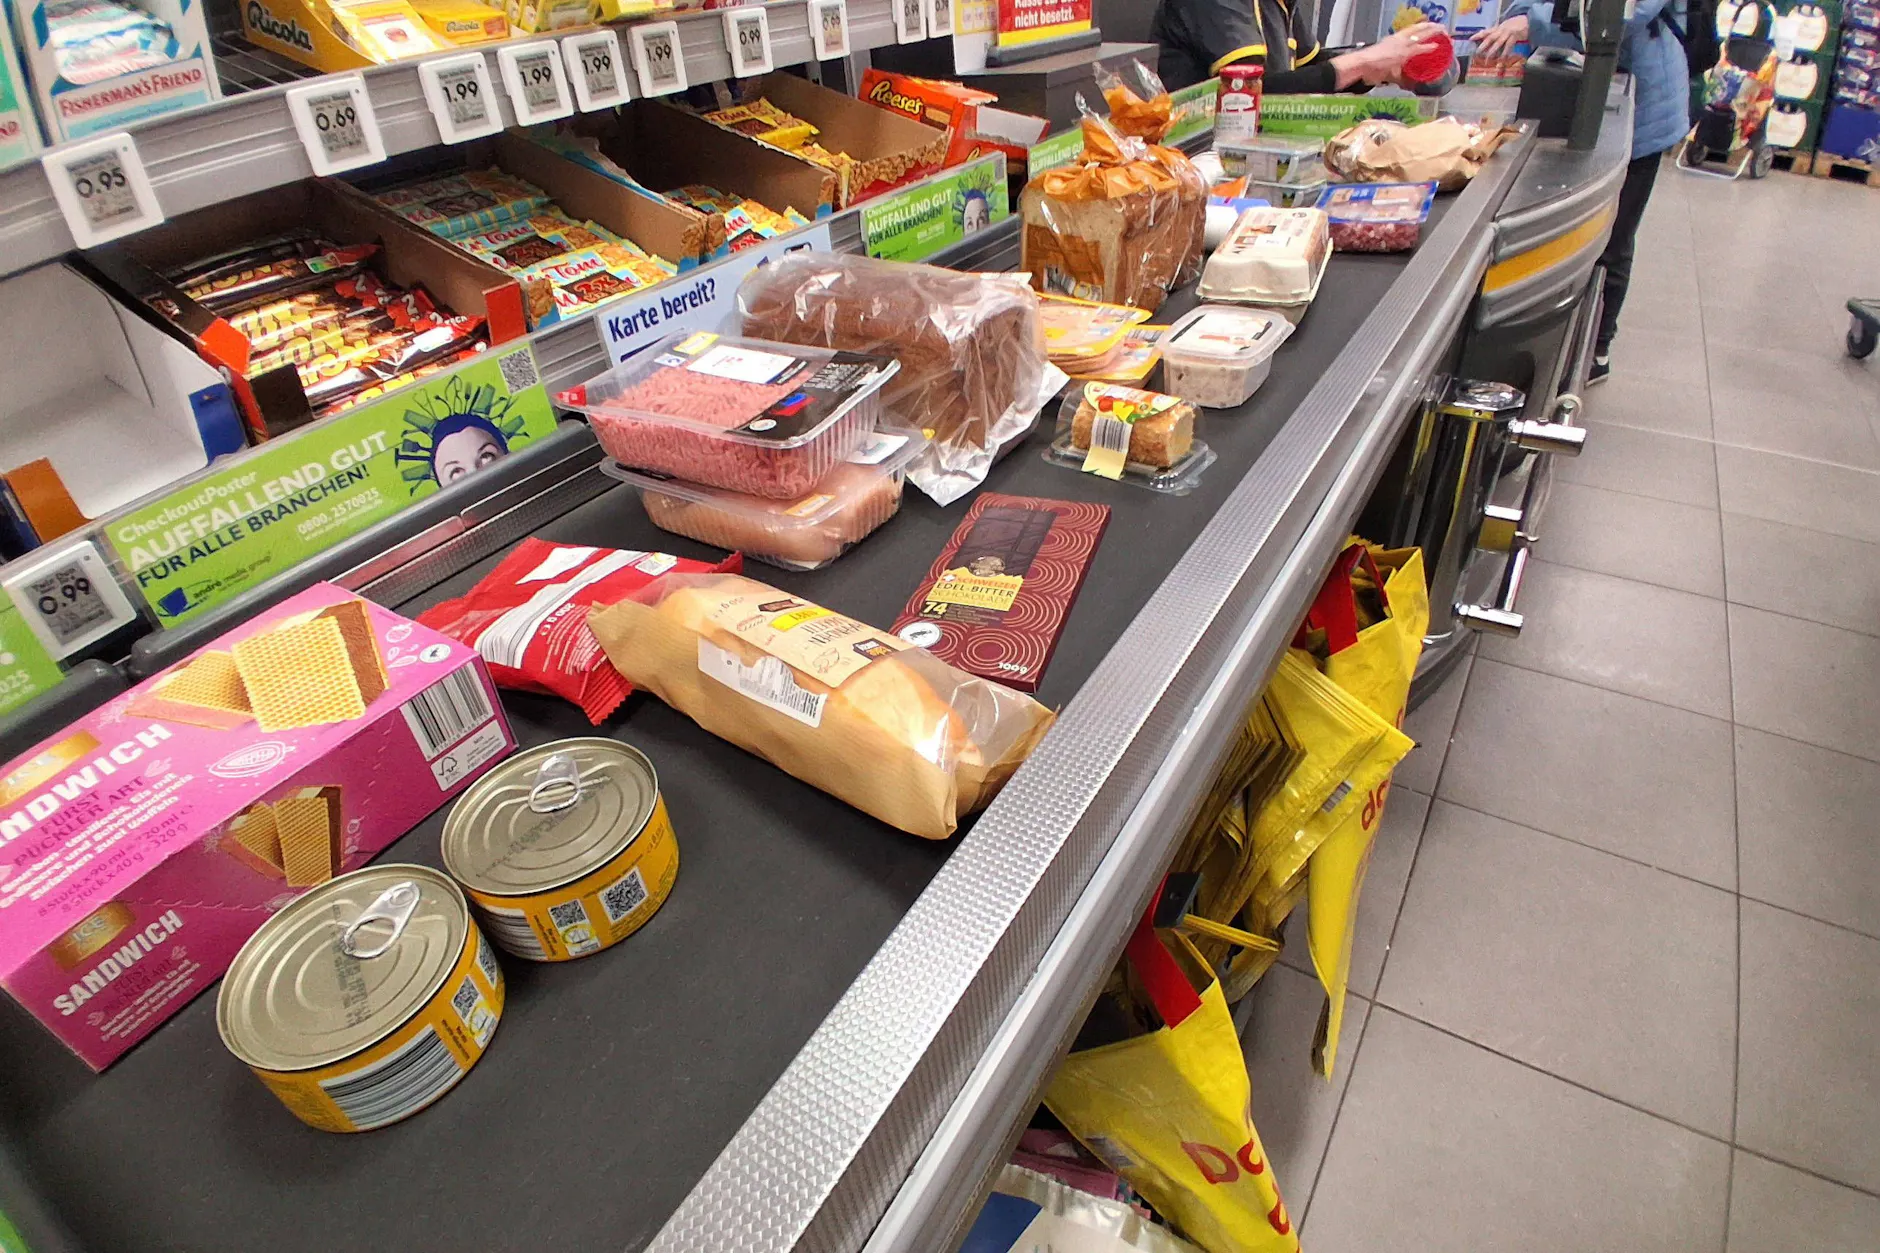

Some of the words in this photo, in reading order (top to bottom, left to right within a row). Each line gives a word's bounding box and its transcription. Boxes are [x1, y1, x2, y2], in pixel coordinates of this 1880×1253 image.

[247, 1, 312, 52] Ricola
[446, 20, 480, 33] Ricola
[1015, 10, 1038, 28] nicht
[1040, 6, 1075, 25] besetzt.
[646, 44, 672, 62] 1.99
[740, 28, 761, 45] 0.99
[520, 66, 552, 88] 1.99
[582, 55, 611, 76] 1.99
[443, 80, 478, 103] 1.99
[871, 79, 924, 116] Reese's
[316, 106, 356, 132] 0.69
[76, 166, 126, 199] 0.95
[868, 198, 930, 234] AUFFALLEND
[932, 188, 952, 207] GUT
[608, 305, 660, 343] Karte
[660, 277, 716, 320] bereit?
[118, 469, 257, 544] CheckoutPoster
[128, 461, 327, 573] AUFFALLEND
[329, 430, 389, 472] GUT
[137, 553, 186, 588] FÜR
[189, 520, 245, 564] ALLE
[247, 464, 371, 533] BRANCHEN!
[38, 577, 91, 615] 0.99
[923, 601, 949, 616] 74
[0, 723, 174, 849] NDWICH
[109, 775, 145, 805] ART
[53, 909, 184, 1017] SANDWICH
